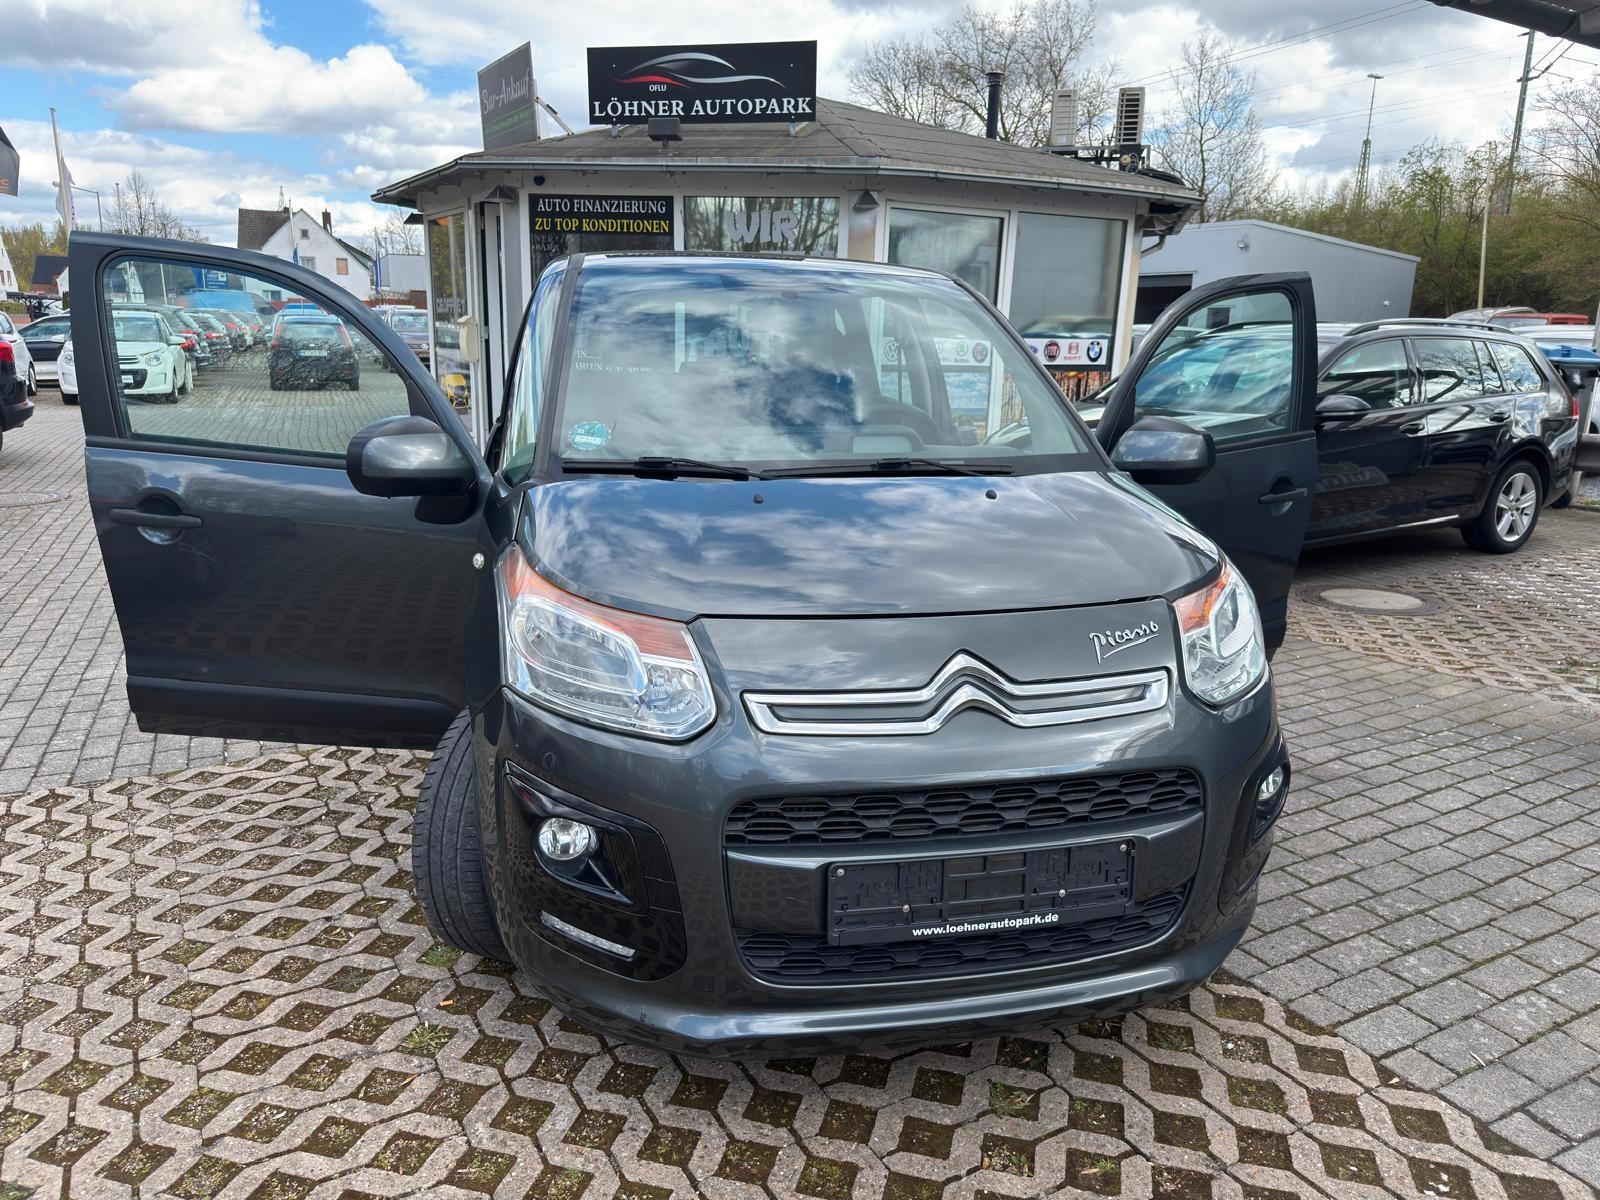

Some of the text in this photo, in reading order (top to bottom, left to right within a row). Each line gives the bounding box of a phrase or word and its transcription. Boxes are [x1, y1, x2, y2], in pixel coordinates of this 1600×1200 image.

[649, 84, 667, 92] OFLU
[593, 97, 813, 117] LÖHNER AUTOPARK
[537, 198, 667, 214] AUTO FINANZIERUNG
[535, 217, 669, 233] ZU TOP KONDITIONEN
[723, 209, 800, 244] WIR
[1089, 621, 1159, 665] Picasso
[912, 913, 1060, 937] www.loehnerautopark.de
